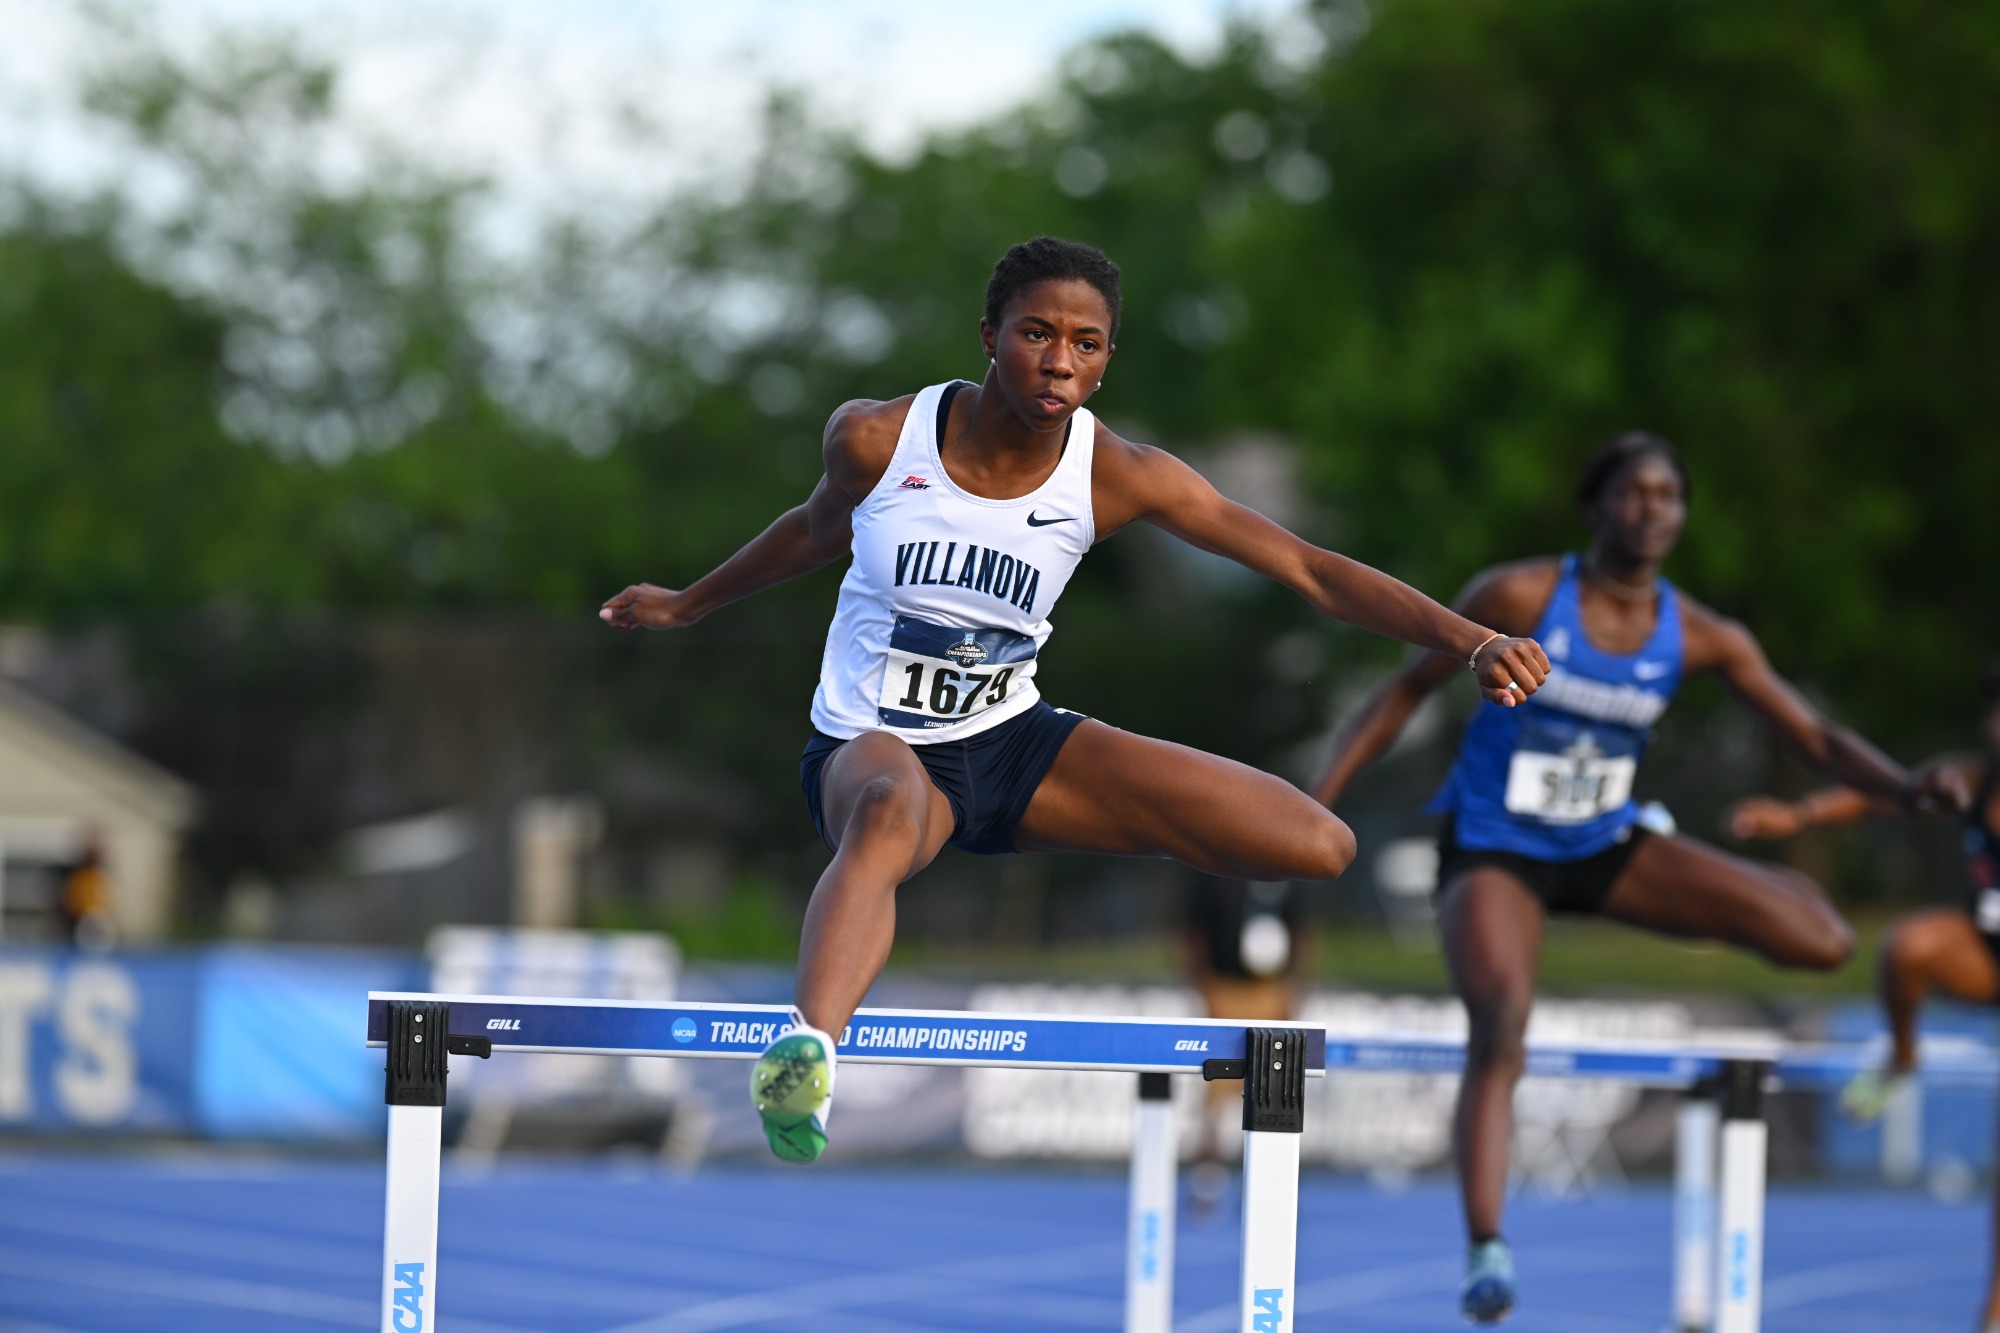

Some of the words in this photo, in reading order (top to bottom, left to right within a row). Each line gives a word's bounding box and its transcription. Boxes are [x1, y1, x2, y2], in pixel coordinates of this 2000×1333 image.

[901, 481, 930, 490] EAST
[906, 476, 927, 484] BIG
[894, 541, 1040, 615] VILLANOVA
[899, 662, 1014, 714] 1679
[486, 1019, 521, 1030] GILL
[674, 1029, 697, 1037] NCAA
[711, 1021, 777, 1044] TRACK
[856, 1026, 1027, 1052] CHAMPIONSHIPS
[1174, 1040, 1209, 1051] GILL
[392, 1263, 425, 1333] CAA
